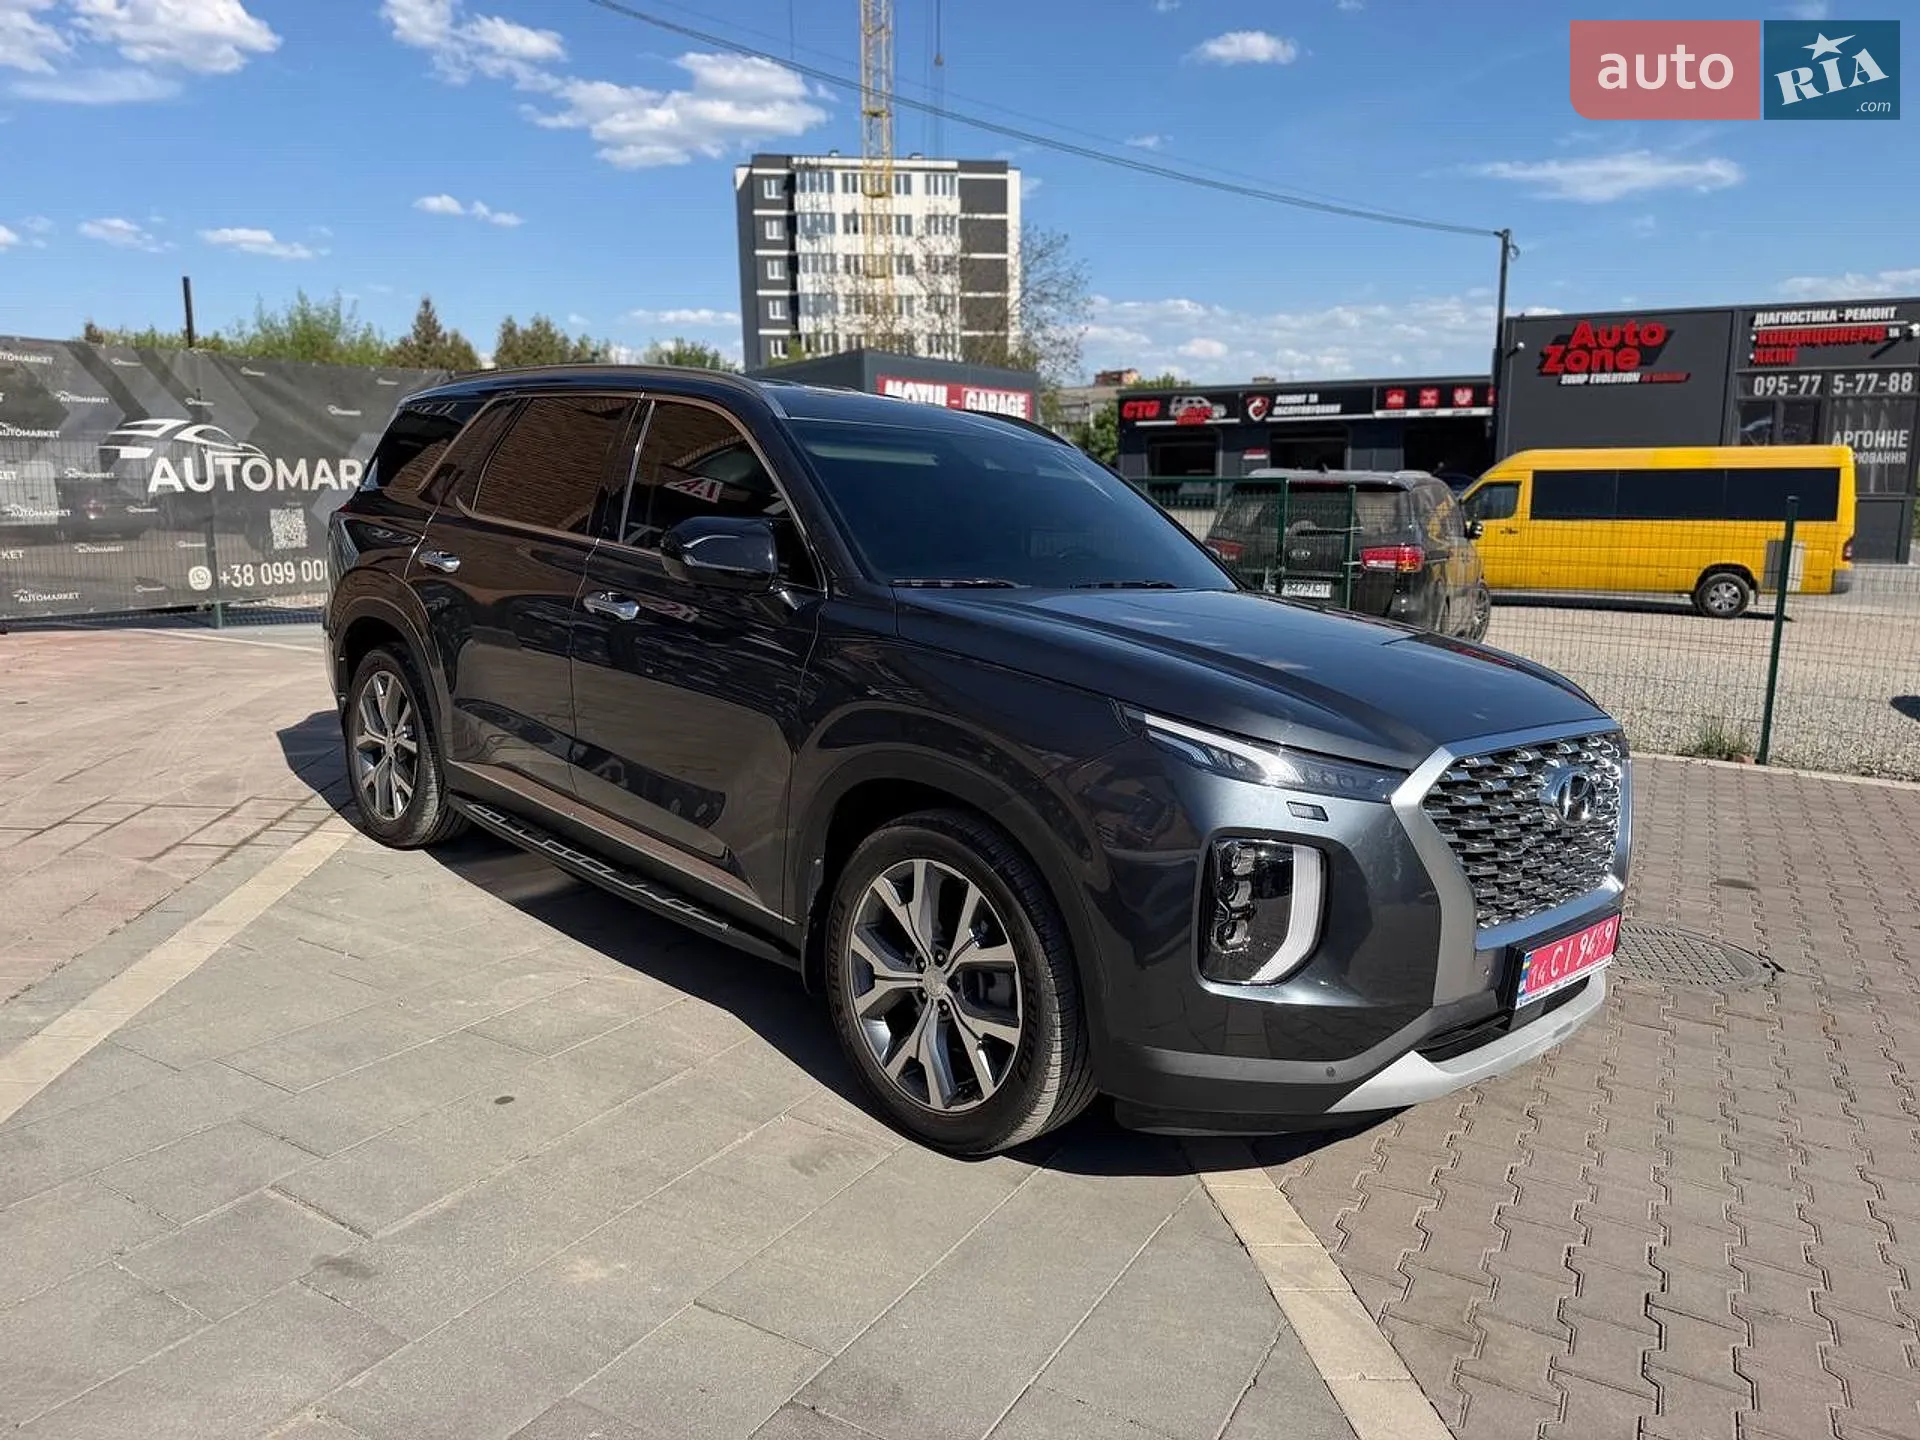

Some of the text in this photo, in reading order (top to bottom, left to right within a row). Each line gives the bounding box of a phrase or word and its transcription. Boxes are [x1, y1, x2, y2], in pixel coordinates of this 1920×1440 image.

[1568, 320, 1667, 348] Auto
[1541, 344, 1641, 373] Zone
[1831, 429, 1909, 449] АРГОННЕ
[147, 455, 367, 493] AUTOMAR
[218, 564, 255, 588] +38
[260, 561, 296, 585] 099
